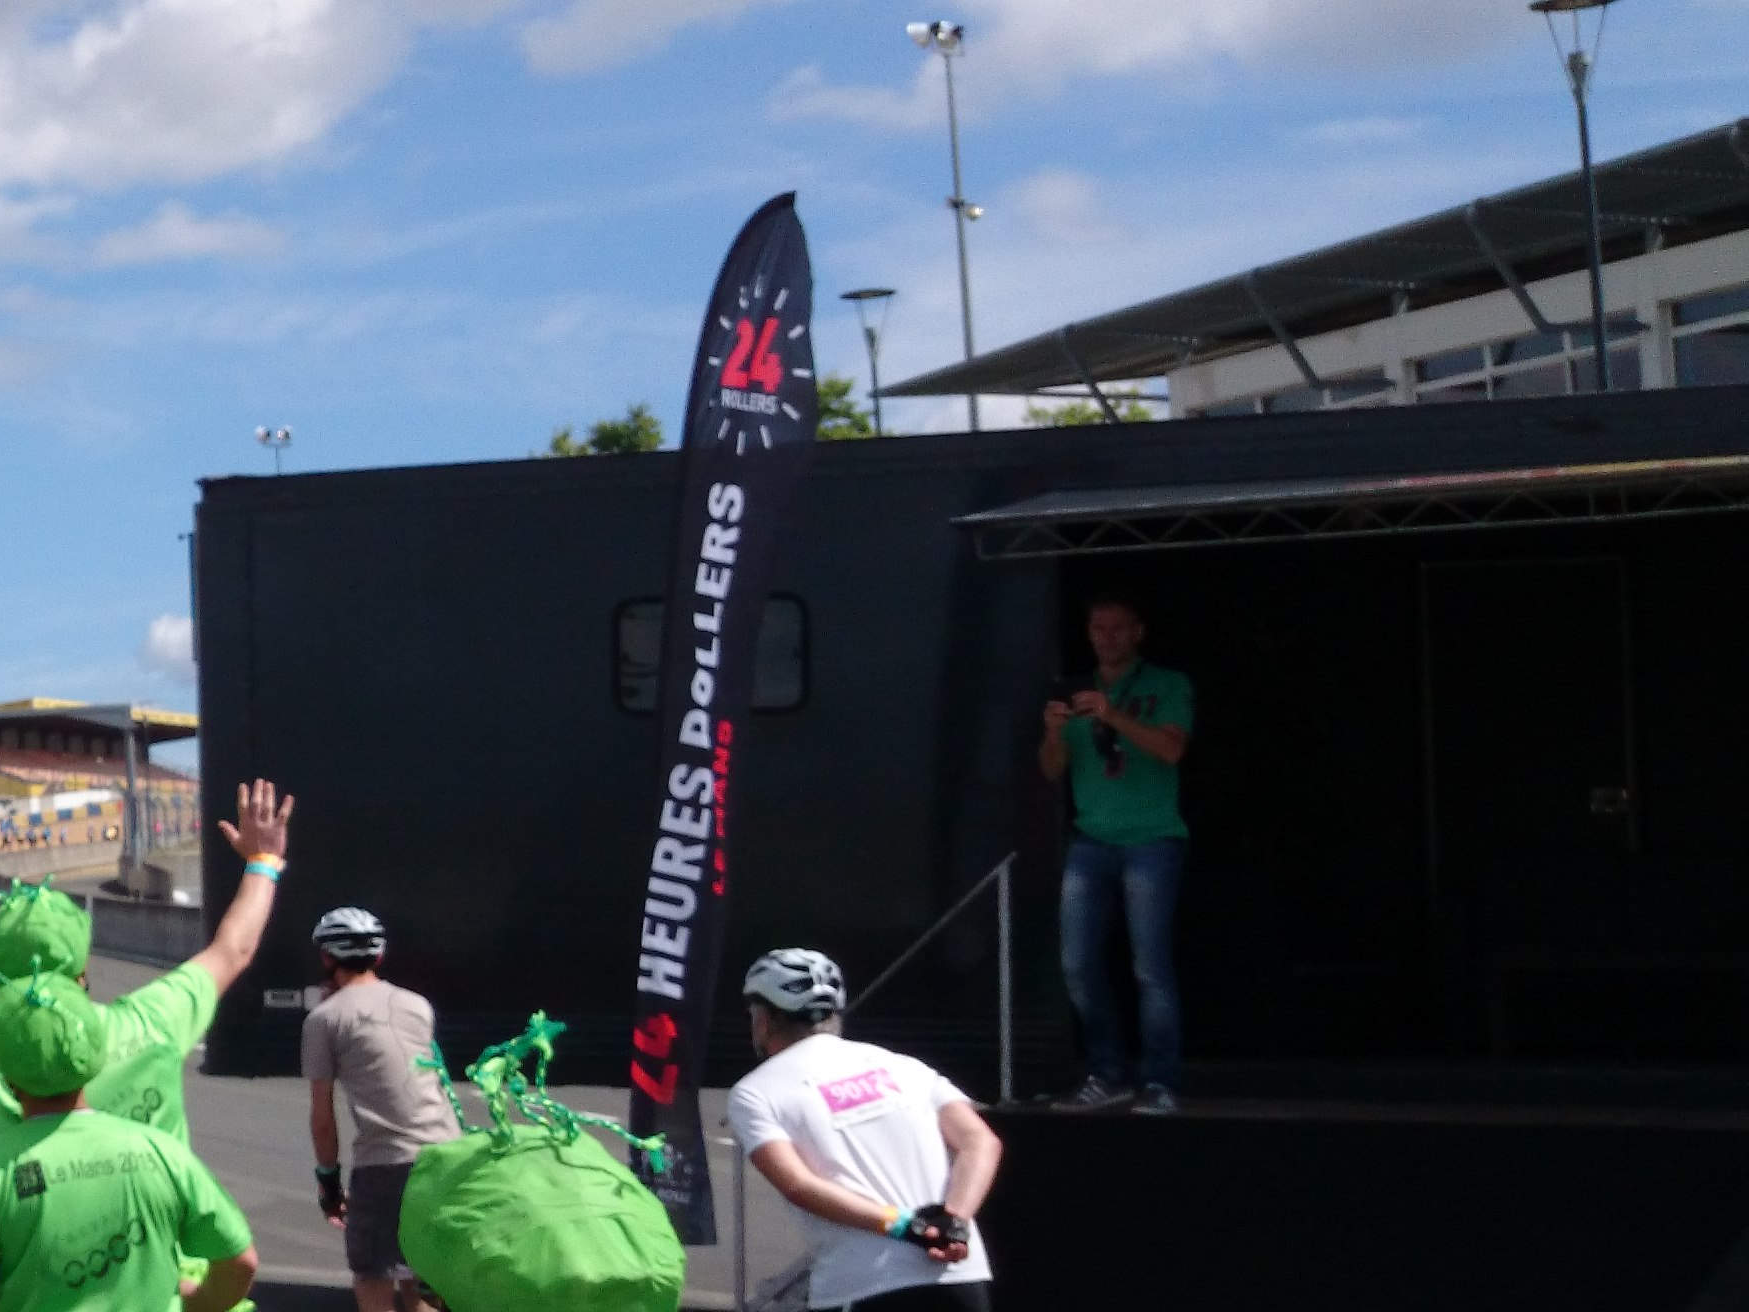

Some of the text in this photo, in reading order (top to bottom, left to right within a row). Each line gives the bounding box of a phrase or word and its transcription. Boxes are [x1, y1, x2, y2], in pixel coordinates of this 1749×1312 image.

[720, 316, 783, 395] 24
[720, 388, 780, 416] ROLLERS
[636, 763, 716, 1001] HEURES
